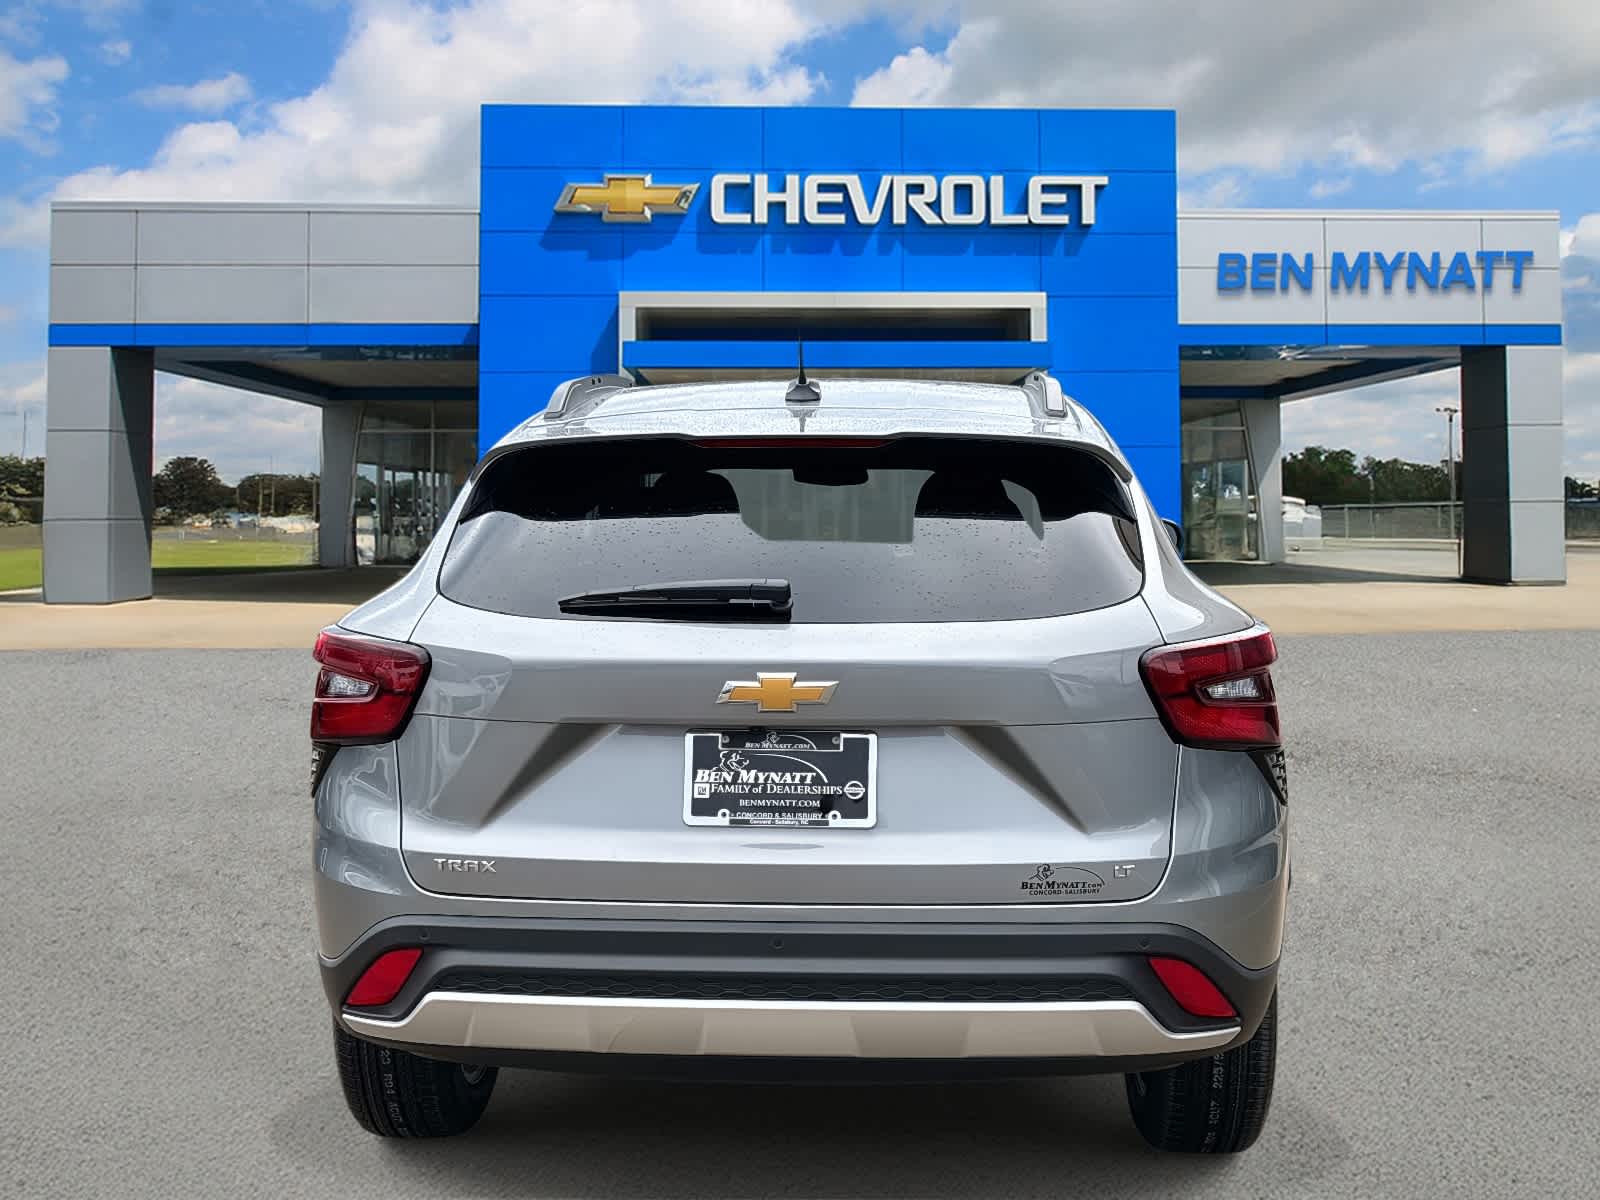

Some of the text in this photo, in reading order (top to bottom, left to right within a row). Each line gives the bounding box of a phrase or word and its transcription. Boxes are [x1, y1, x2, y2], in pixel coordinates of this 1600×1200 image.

[711, 173, 1109, 225] CHEVROLET
[1216, 250, 1534, 290] BEN MYNATT
[695, 769, 816, 784] BEN MYNATT
[711, 783, 751, 793] FAMILY
[752, 783, 764, 793] of
[766, 783, 843, 794] DEALERSHIPS
[432, 858, 497, 872] TRAX
[1114, 864, 1135, 878] LT
